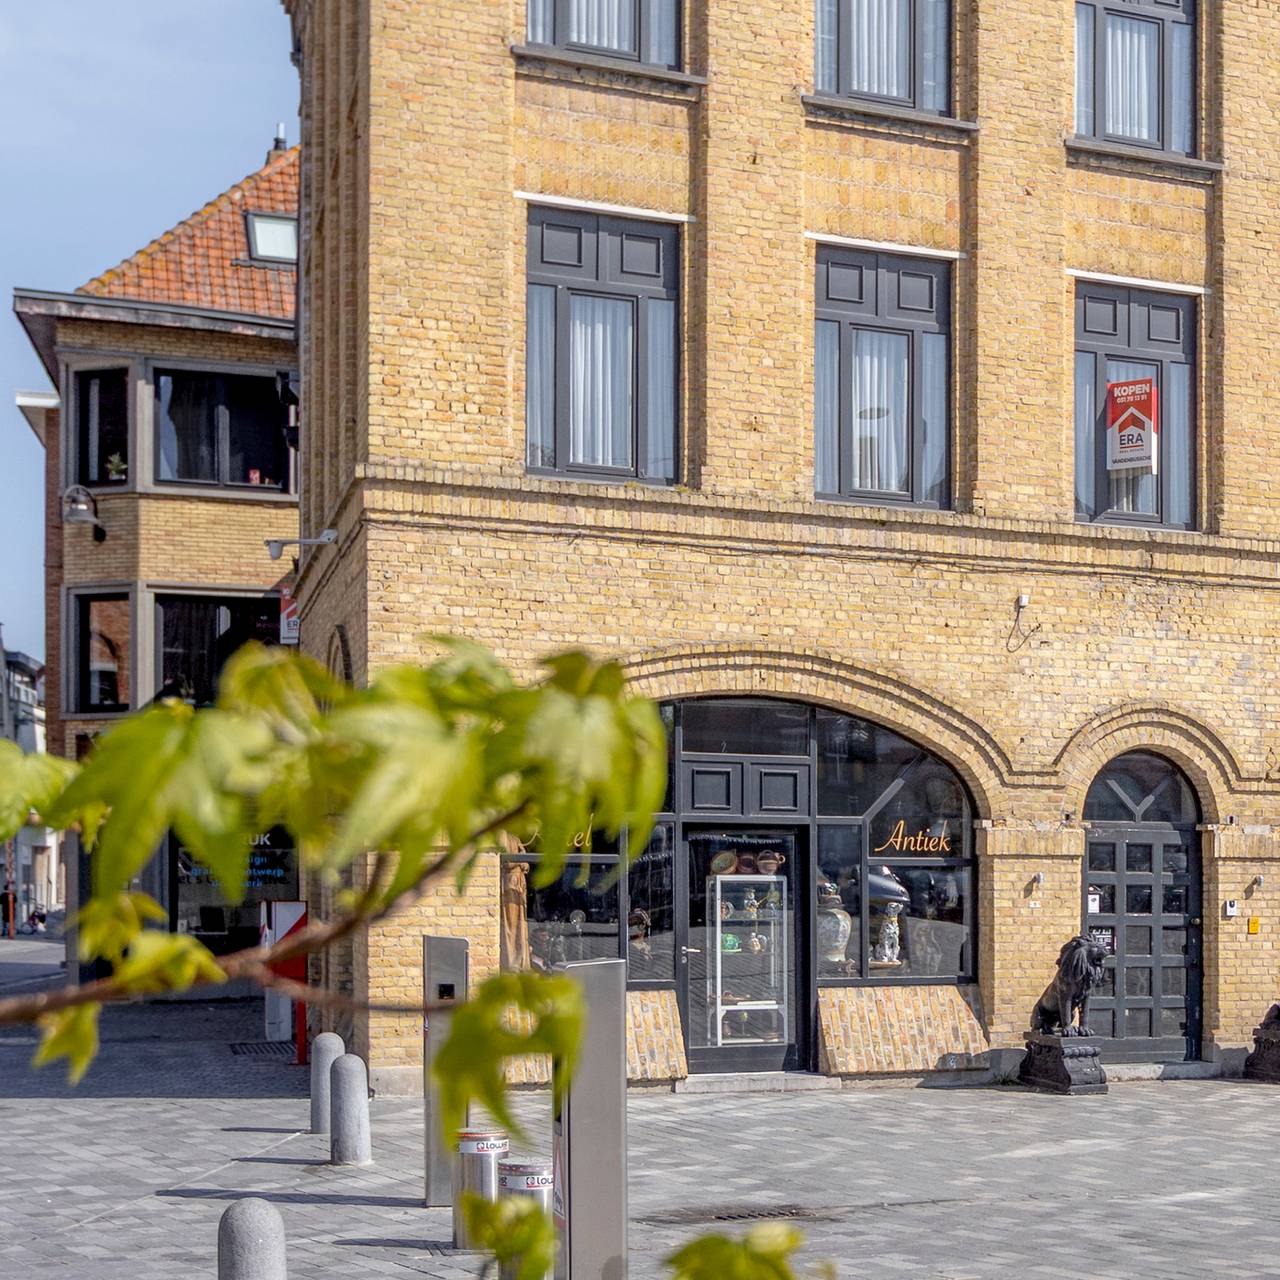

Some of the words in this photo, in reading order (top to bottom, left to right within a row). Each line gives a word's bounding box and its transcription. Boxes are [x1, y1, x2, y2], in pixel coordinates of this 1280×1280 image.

[1114, 384, 1150, 397] KOPEN
[1120, 433, 1144, 445] ERA
[874, 819, 951, 852] Antiek
